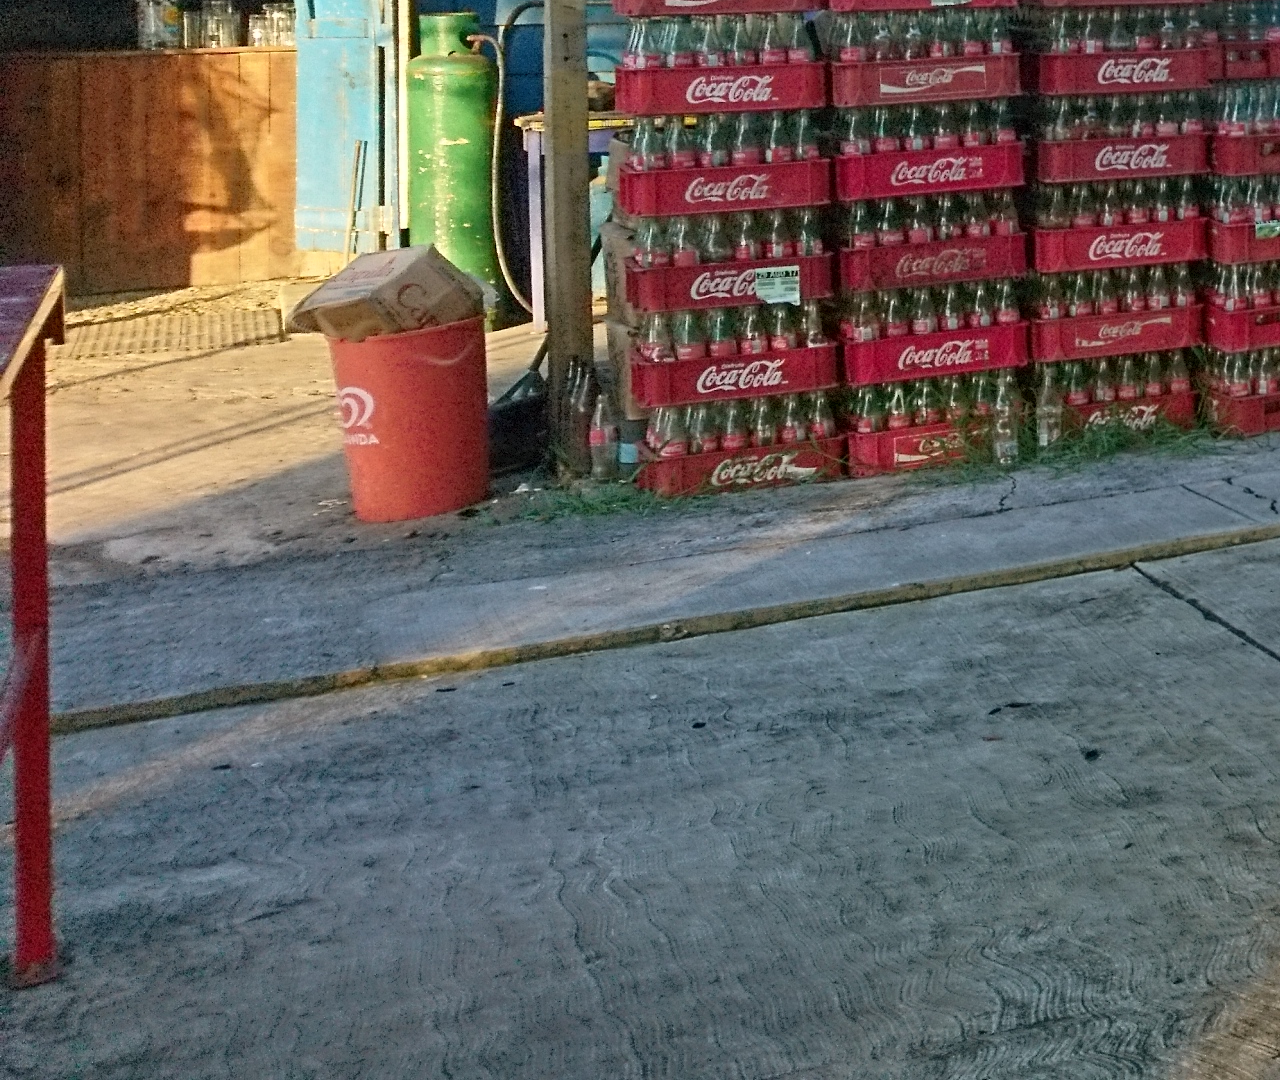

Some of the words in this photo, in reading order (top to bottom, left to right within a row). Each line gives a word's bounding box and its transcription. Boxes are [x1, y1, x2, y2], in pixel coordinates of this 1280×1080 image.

[906, 67, 954, 86] Coca-Cola
[1098, 58, 1171, 84] Coca-Cola
[686, 75, 773, 104] Coca-Cola
[891, 156, 967, 186] Coca-Cola
[1095, 143, 1169, 170] Coca-Cola
[685, 173, 771, 204] Coca-Cola
[1089, 231, 1164, 260] Coca-Cola
[1098, 324, 1142, 338] Coca-Cola
[898, 340, 974, 370] Coca-Cola
[697, 359, 786, 393] Coca-Cola
